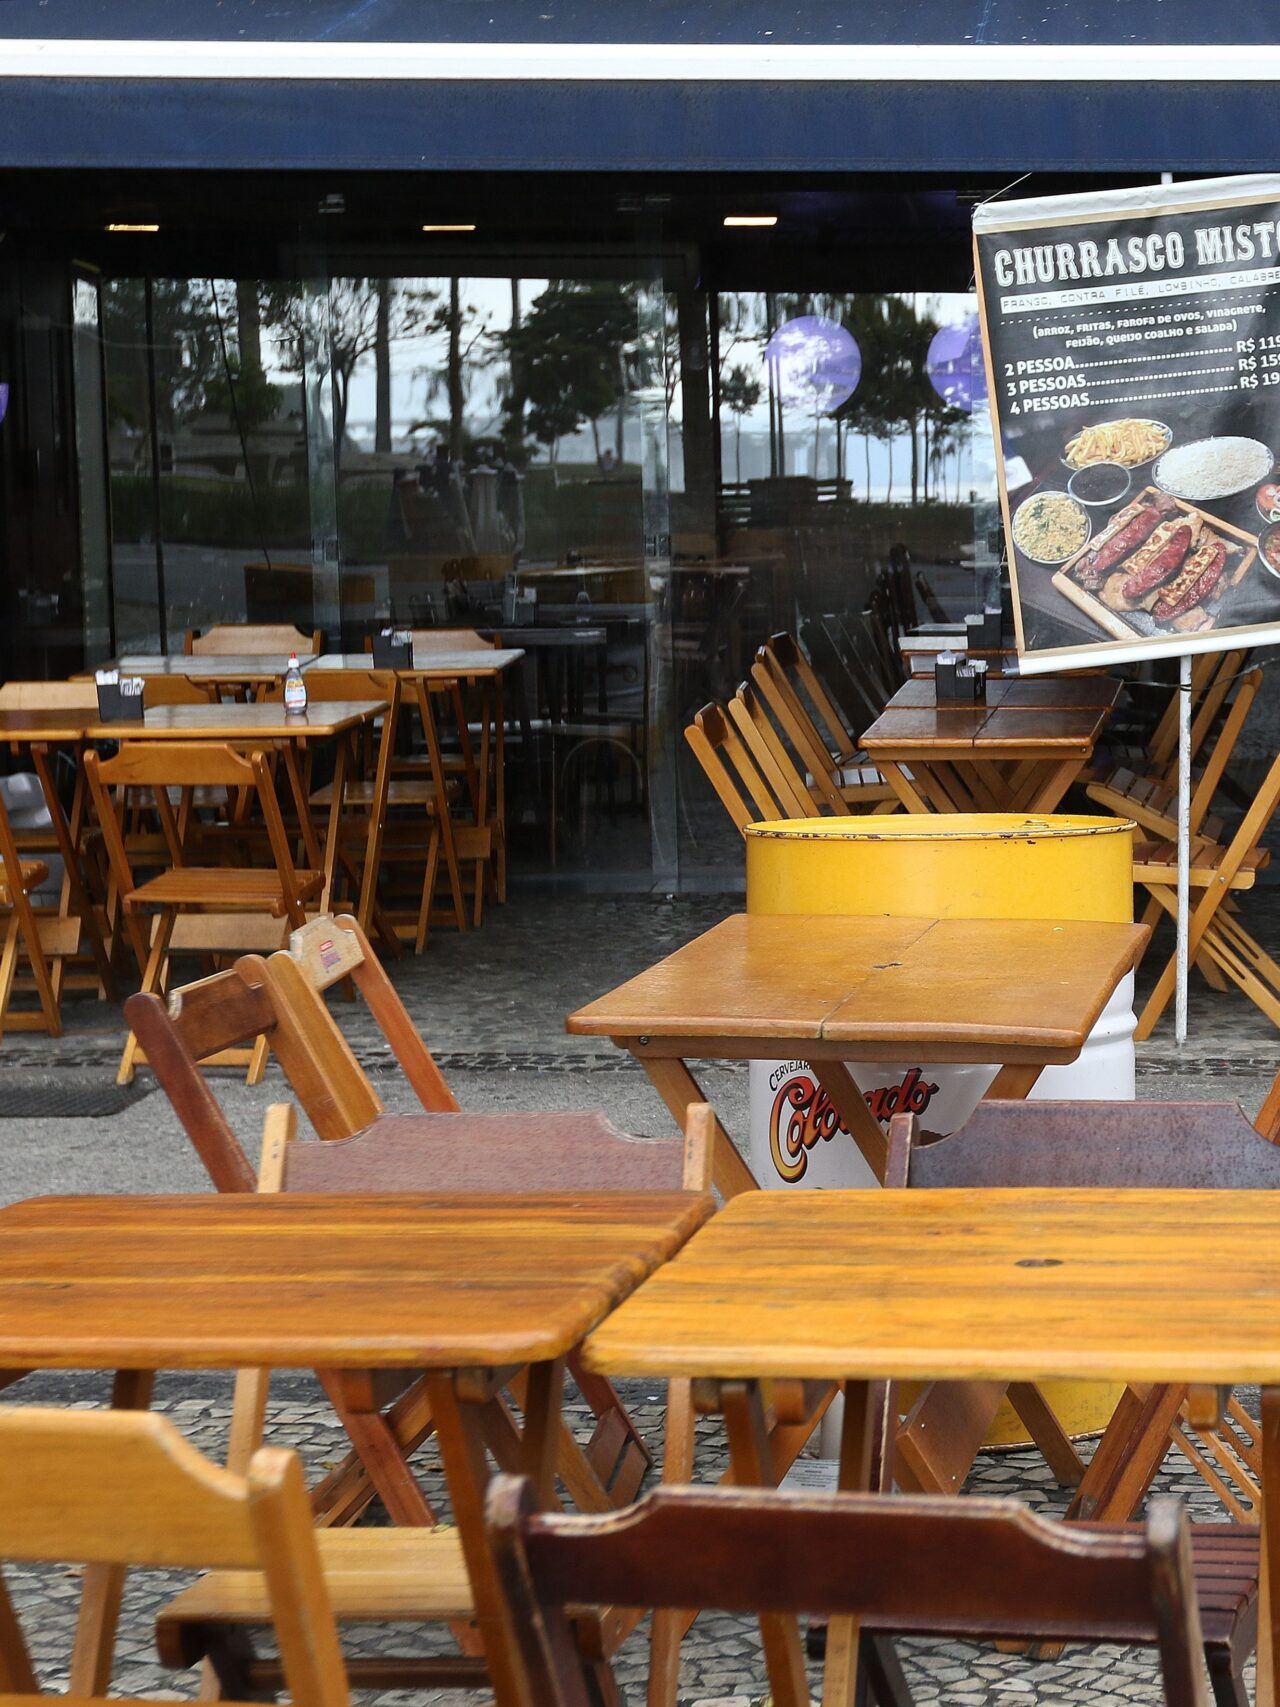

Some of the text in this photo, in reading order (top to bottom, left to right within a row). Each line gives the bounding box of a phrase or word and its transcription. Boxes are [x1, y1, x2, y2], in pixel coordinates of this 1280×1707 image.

[994, 232, 1185, 287] CHURRASCO
[1003, 296, 1051, 309] FRANGO,
[1060, 290, 1105, 303] CONTRA
[1115, 285, 1149, 297] FILÉ,
[1004, 363, 1014, 376] 2
[1236, 337, 1256, 353] R$
[1007, 382, 1017, 396] 3
[1238, 355, 1257, 371] R$
[1010, 401, 1021, 415] 4
[1240, 373, 1259, 389] R$
